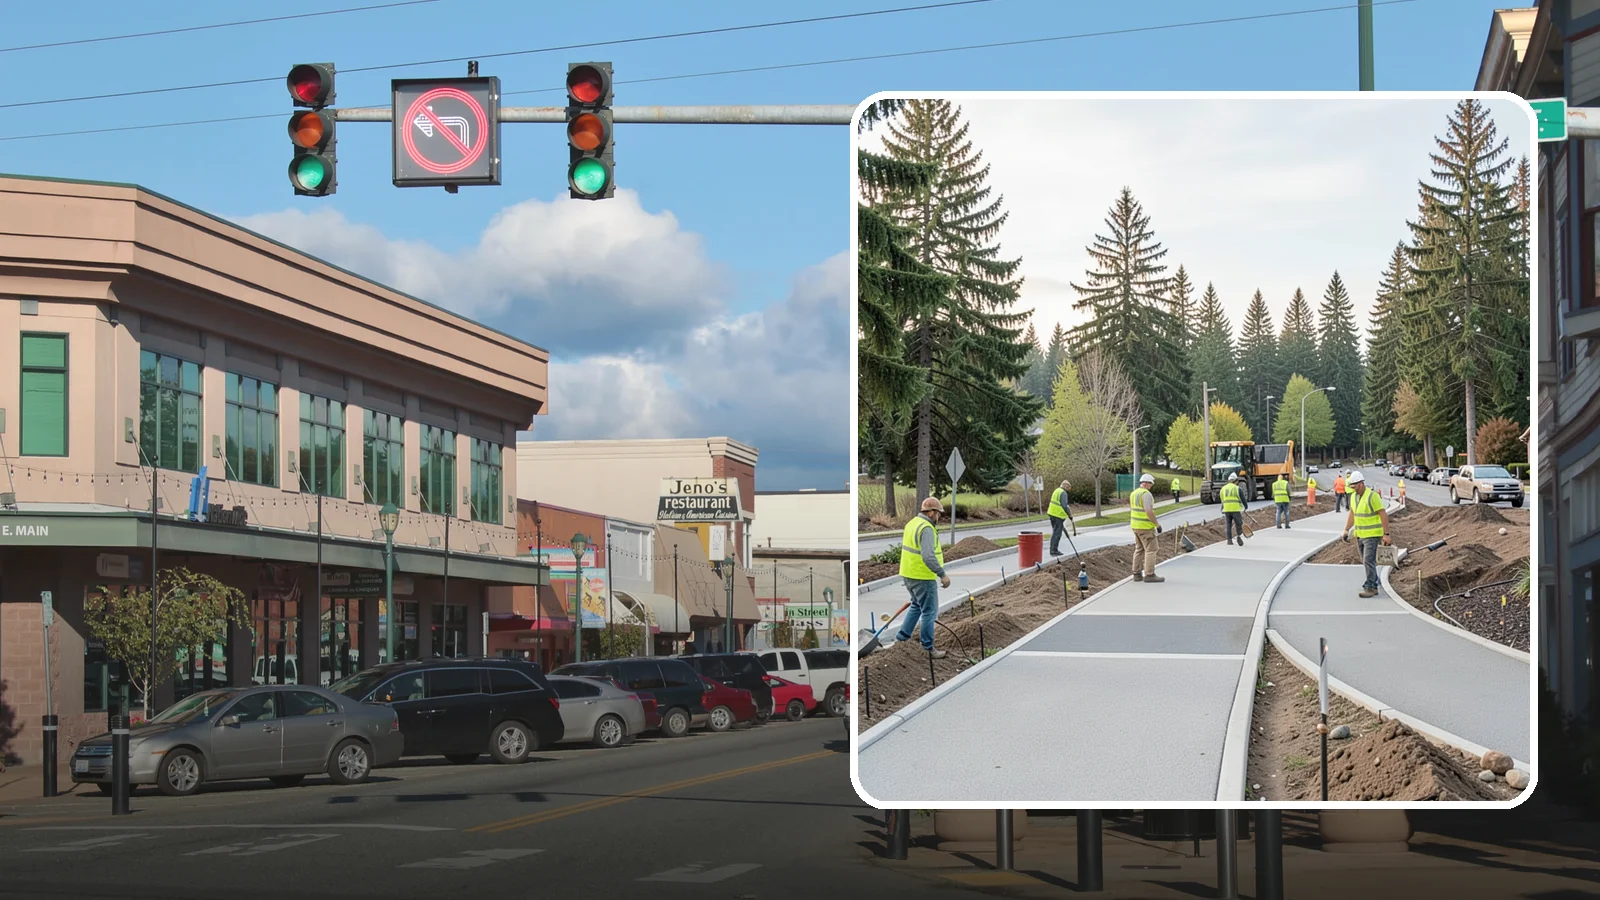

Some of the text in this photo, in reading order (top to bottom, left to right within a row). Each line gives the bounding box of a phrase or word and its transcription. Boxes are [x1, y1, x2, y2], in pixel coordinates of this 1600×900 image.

[670, 480, 727, 494] Jeno's
[665, 497, 731, 509] restaurant
[659, 510, 681, 519] Italian
[686, 510, 714, 519] American
[715, 509, 737, 519] Cuisine
[2, 525, 49, 536] E. MAIN
[797, 608, 829, 616] Street
